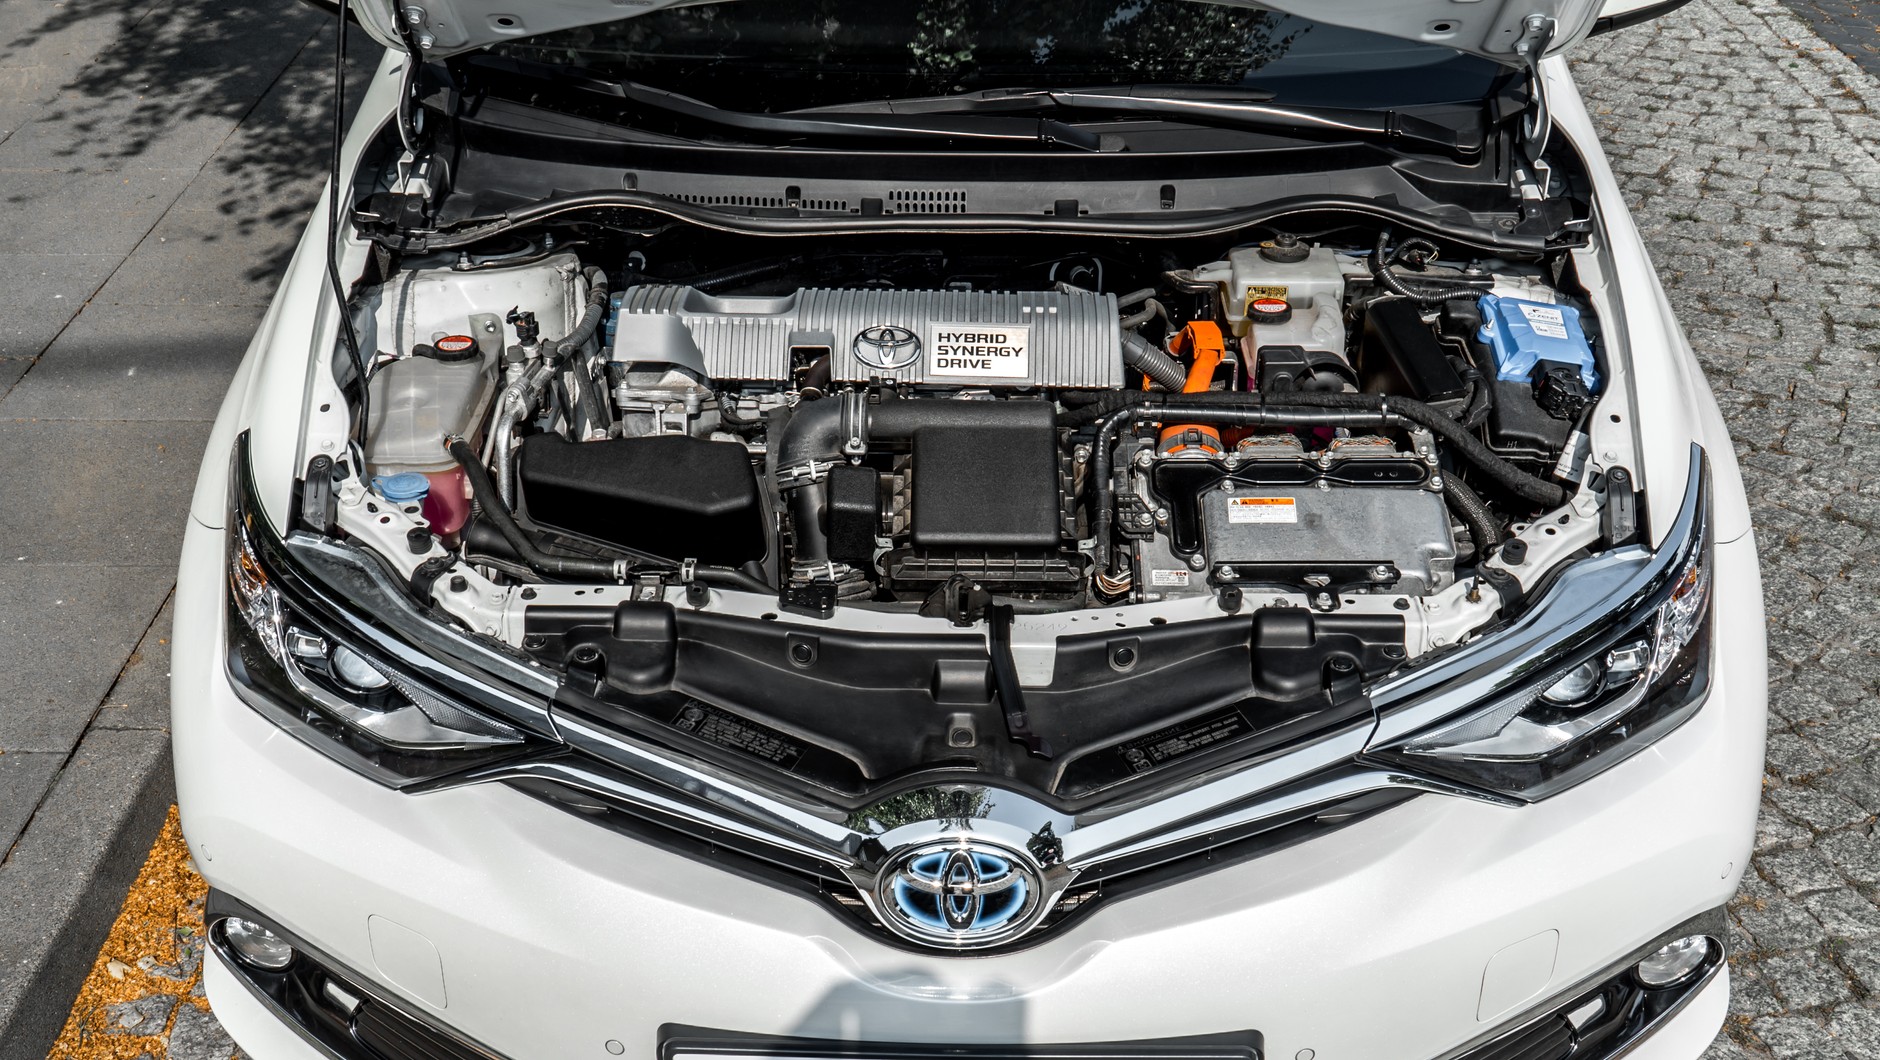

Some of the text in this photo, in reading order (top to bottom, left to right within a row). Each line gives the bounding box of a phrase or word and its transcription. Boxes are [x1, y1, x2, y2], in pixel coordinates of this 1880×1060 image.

[938, 333, 1007, 344] HYBRID
[937, 345, 1024, 357] SYNERGY
[937, 359, 992, 369] DRIVE
